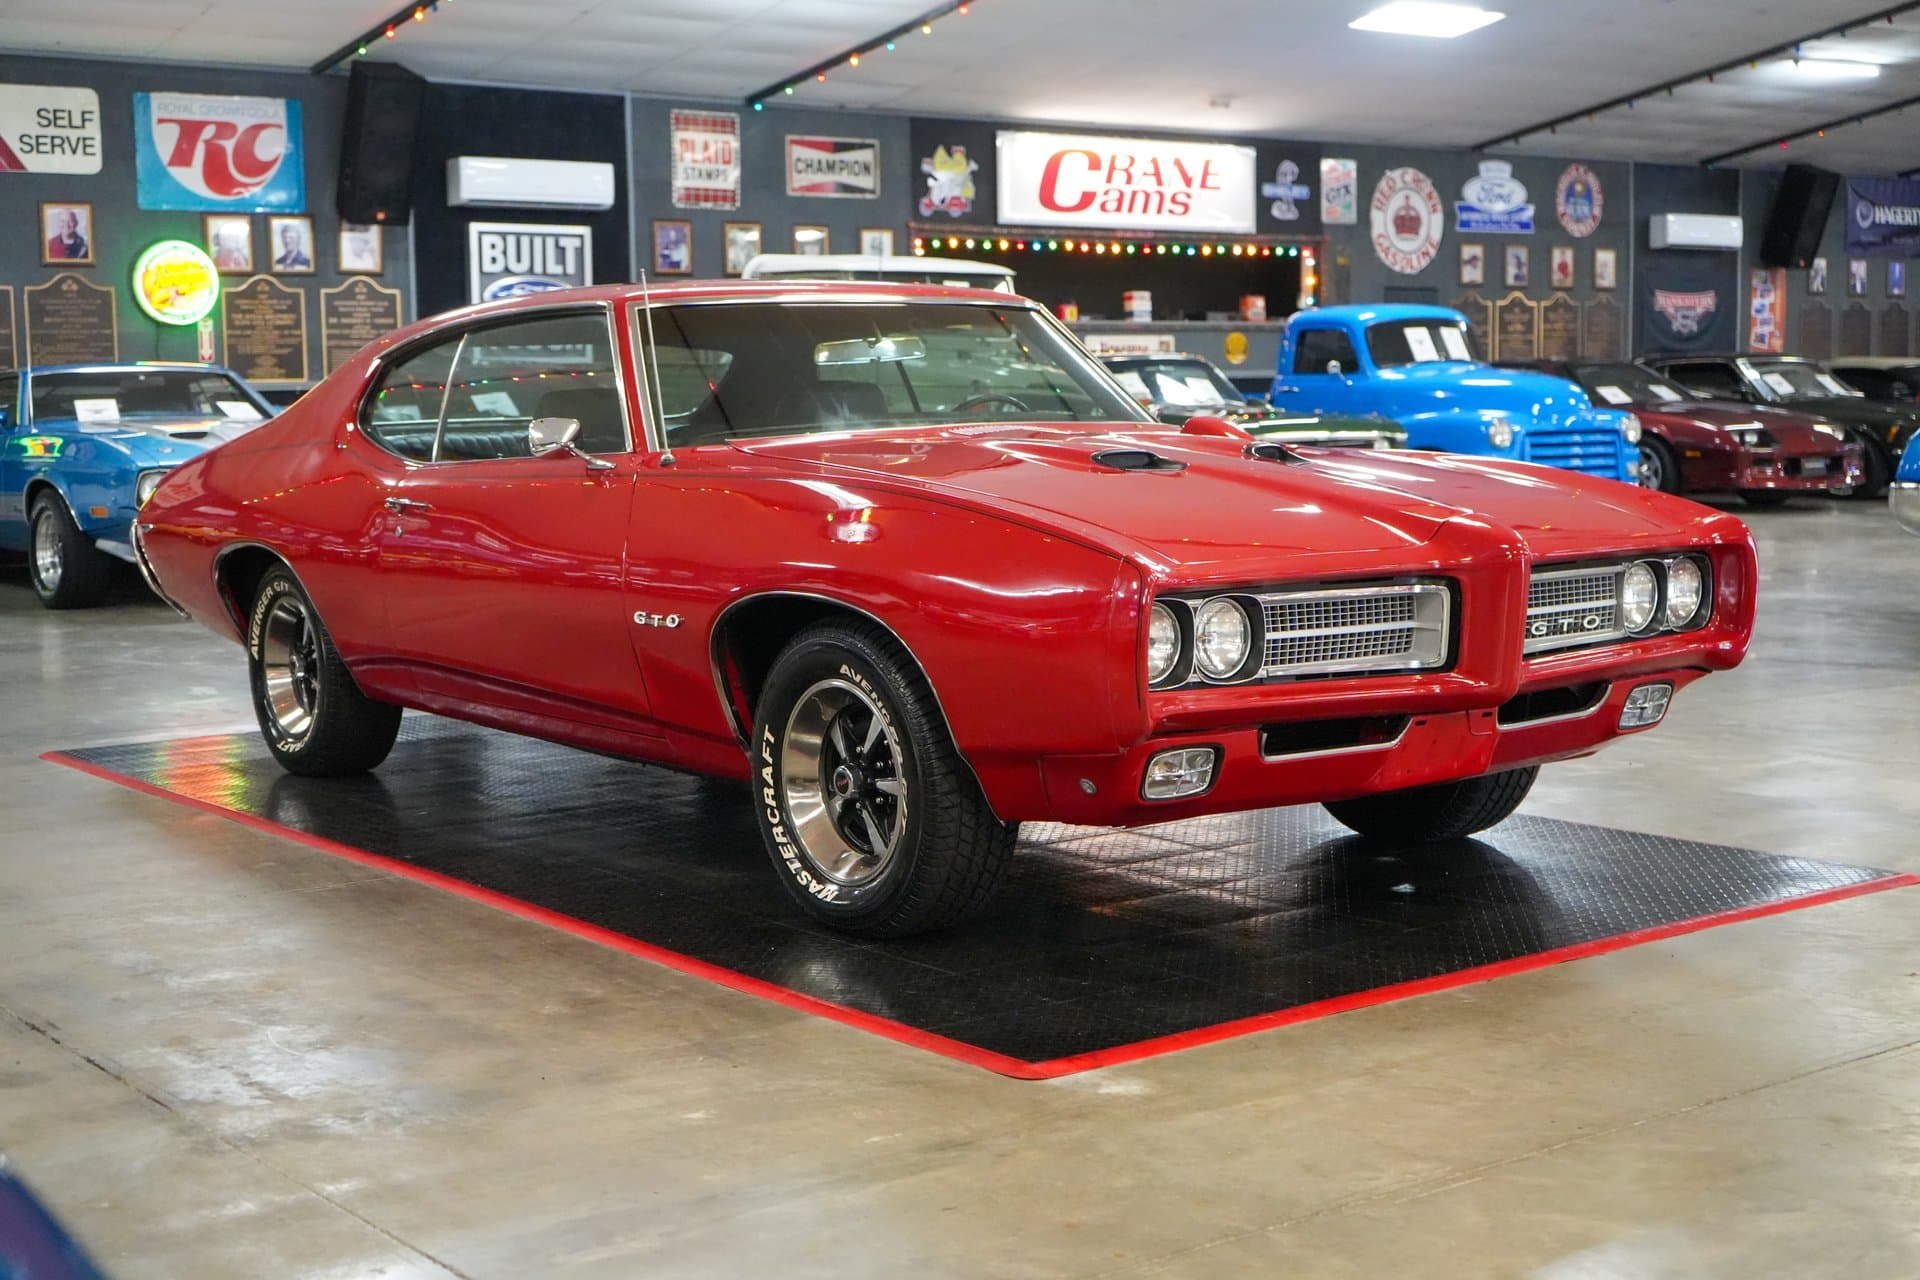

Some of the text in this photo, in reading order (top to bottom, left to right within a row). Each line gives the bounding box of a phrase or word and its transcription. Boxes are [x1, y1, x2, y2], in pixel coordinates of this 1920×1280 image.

[36, 107, 95, 129] SELF
[19, 134, 97, 156] SERVE
[157, 118, 283, 197] RC
[679, 139, 732, 165] PLAID
[683, 166, 728, 181] STAMPS
[794, 157, 872, 177] CHAMPION
[1038, 149, 1222, 213] CRANE
[1374, 175, 1397, 212] RED
[481, 233, 582, 275] BUILT
[250, 585, 274, 661] AVENGER
[633, 610, 681, 628] GTO
[1531, 615, 1601, 636] GTO
[761, 723, 840, 902] MASTERCRAFT
